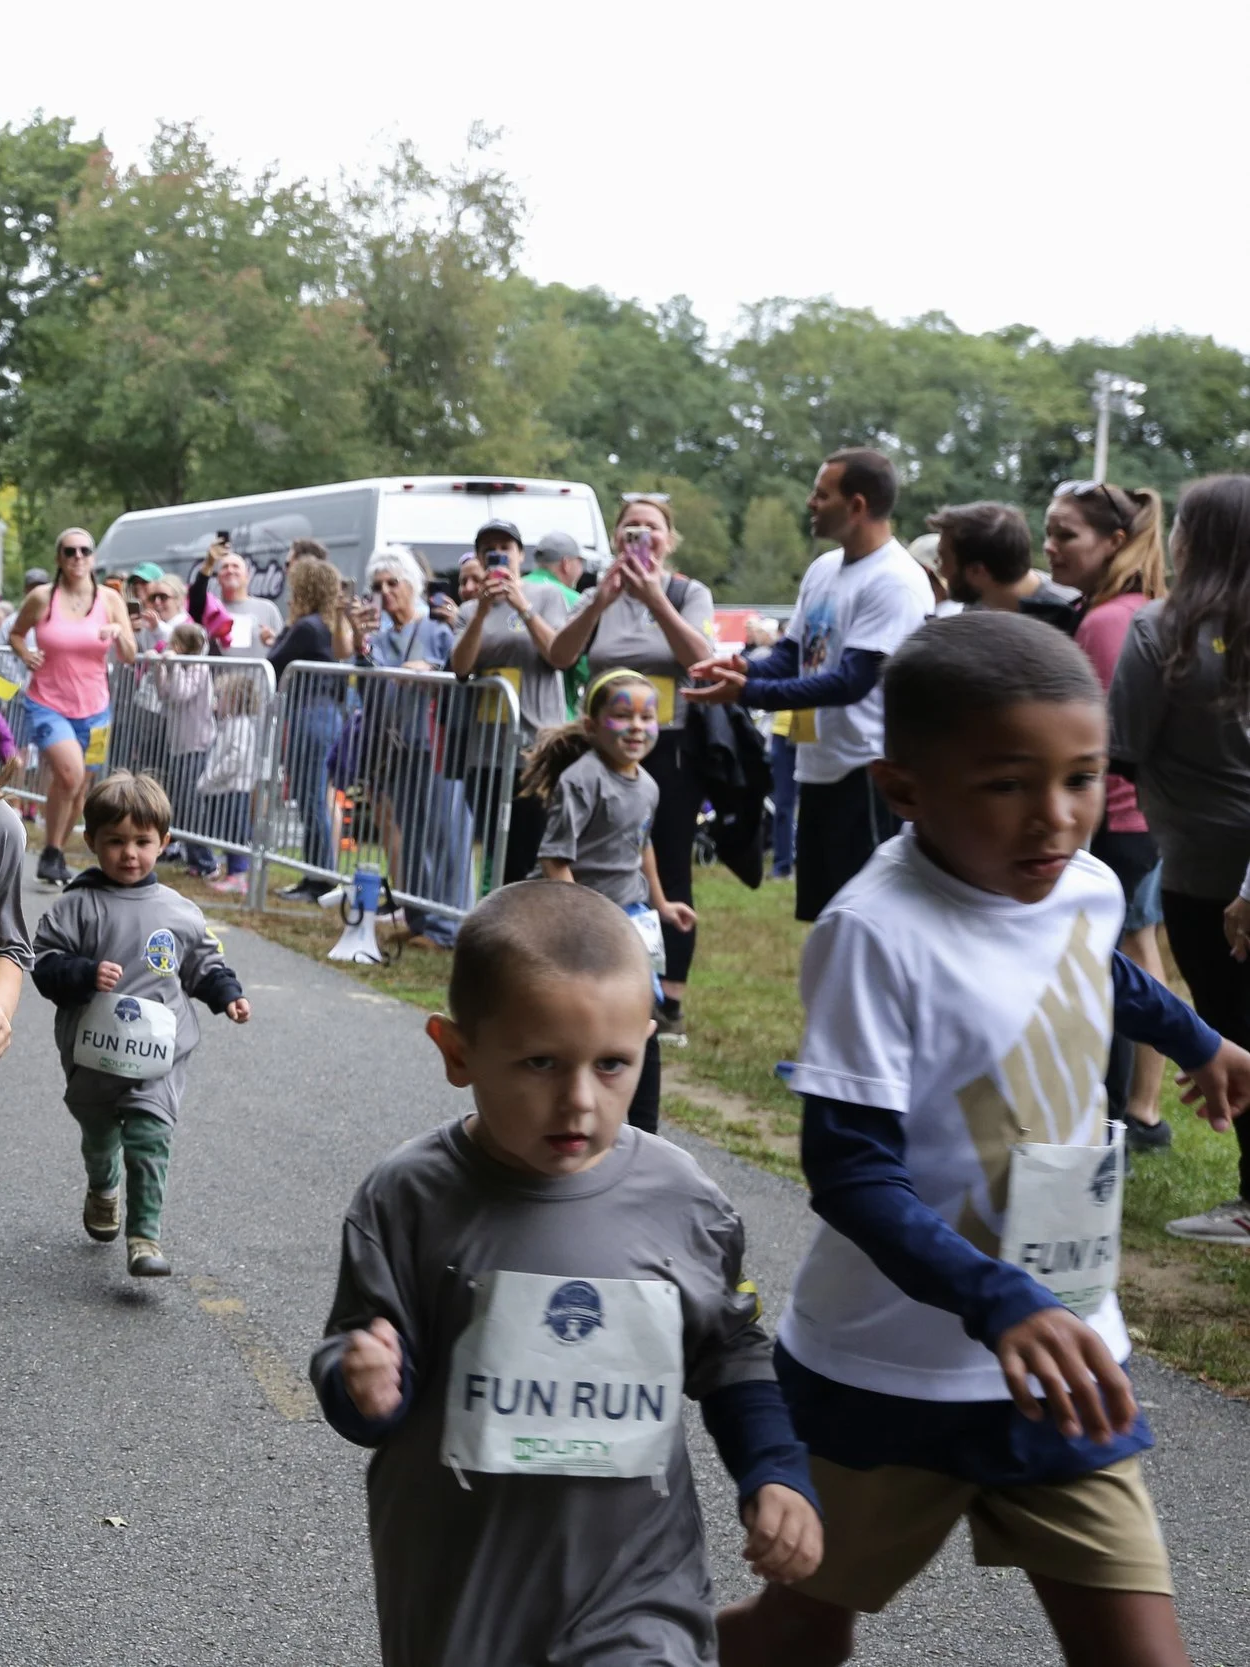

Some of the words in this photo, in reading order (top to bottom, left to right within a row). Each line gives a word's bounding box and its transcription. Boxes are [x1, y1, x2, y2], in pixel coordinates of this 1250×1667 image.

[82, 1030, 119, 1052] FUN
[125, 1039, 167, 1060] RUN
[463, 1374, 557, 1417] FUN
[571, 1381, 665, 1422] RUN
